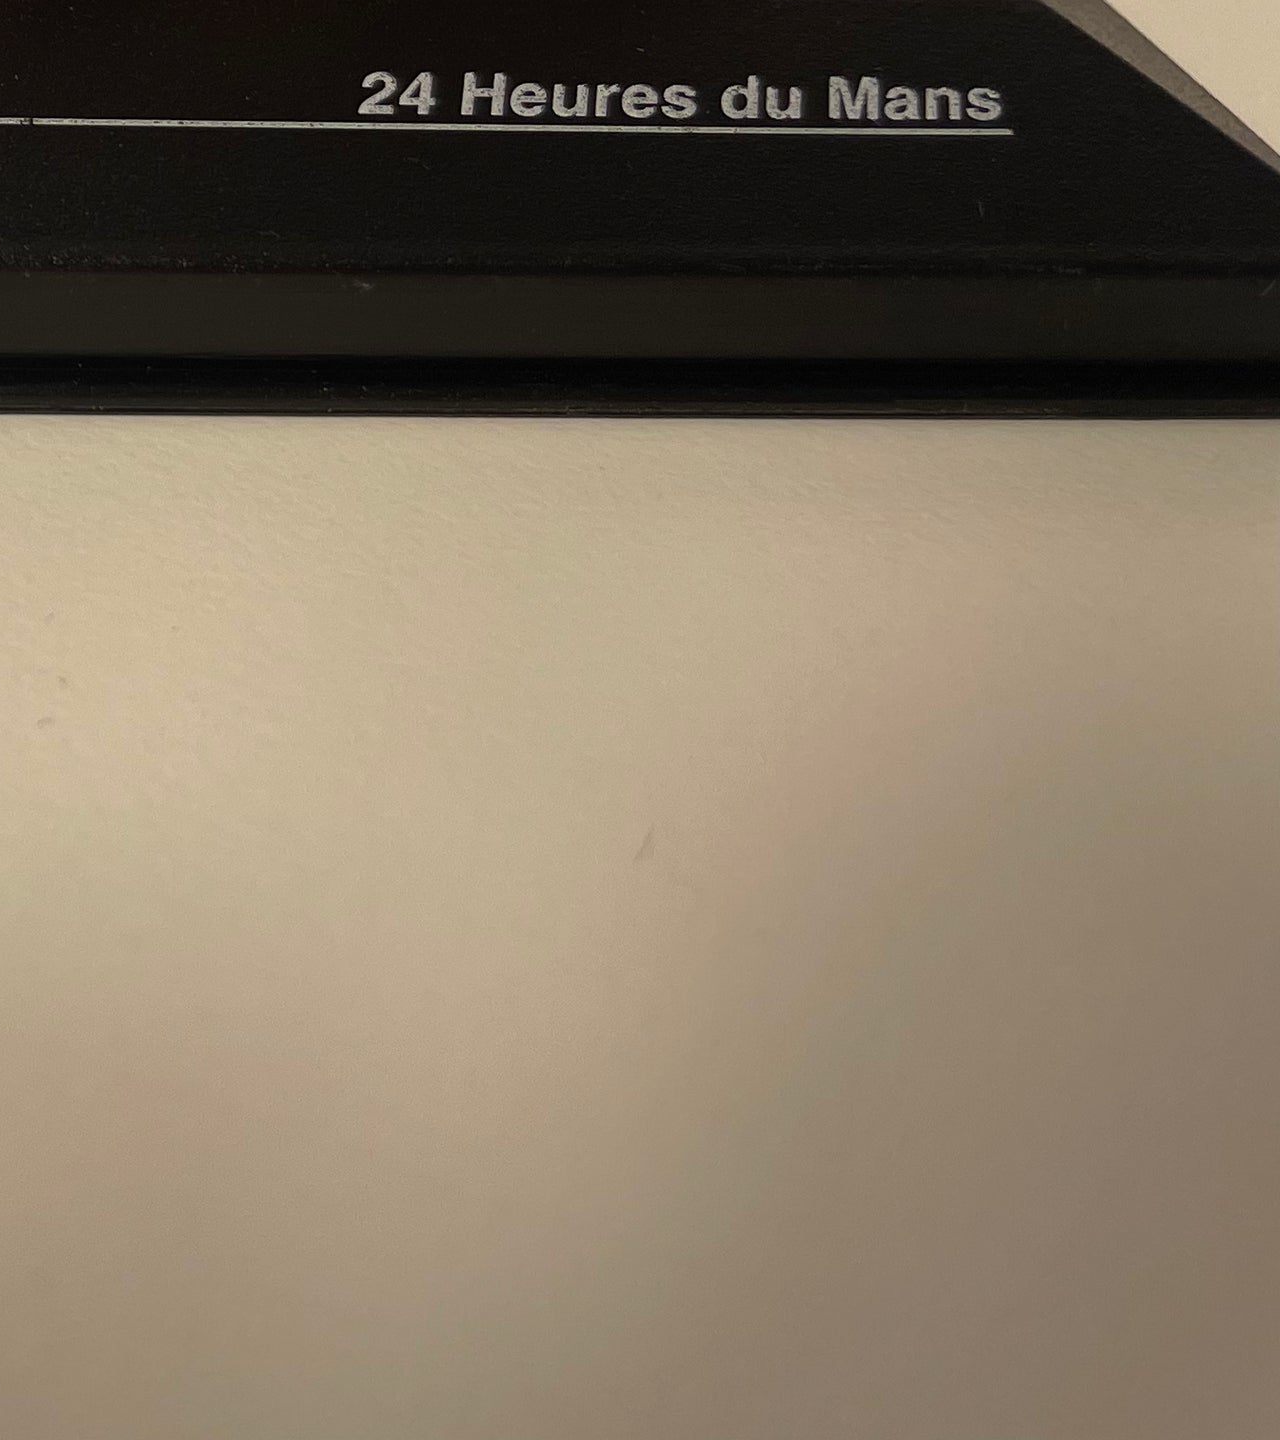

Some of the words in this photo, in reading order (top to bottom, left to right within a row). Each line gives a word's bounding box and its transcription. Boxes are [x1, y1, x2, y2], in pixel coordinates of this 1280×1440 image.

[356, 70, 437, 117] 24
[460, 71, 698, 120] Heures
[720, 74, 803, 122] du
[827, 75, 1004, 122] Mans
